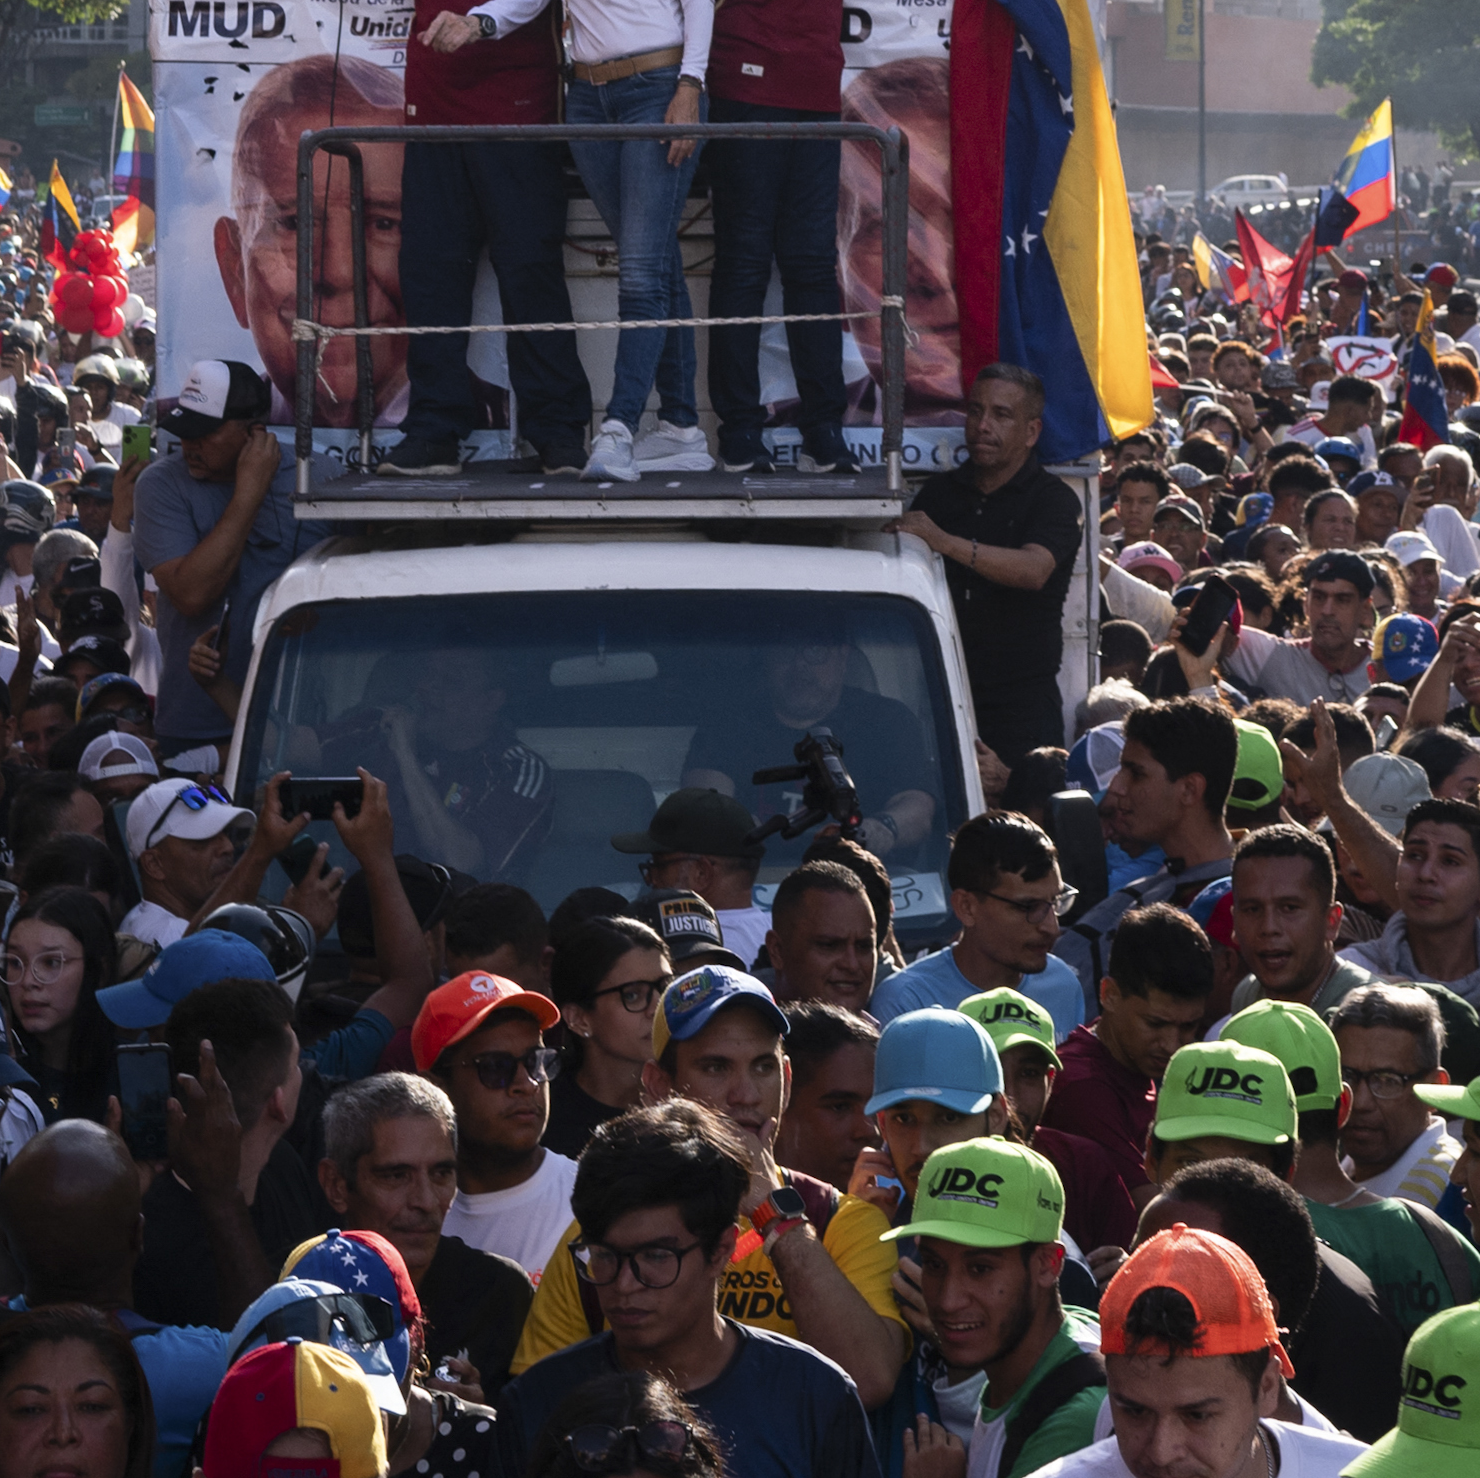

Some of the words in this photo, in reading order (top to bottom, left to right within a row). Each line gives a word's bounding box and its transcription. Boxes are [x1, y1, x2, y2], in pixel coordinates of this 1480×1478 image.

[168, 0, 287, 39] MUD
[350, 15, 412, 39] Unid
[981, 1003, 1041, 1026] JDC
[1187, 1067, 1264, 1096] JDC
[928, 1167, 1005, 1198] JDC
